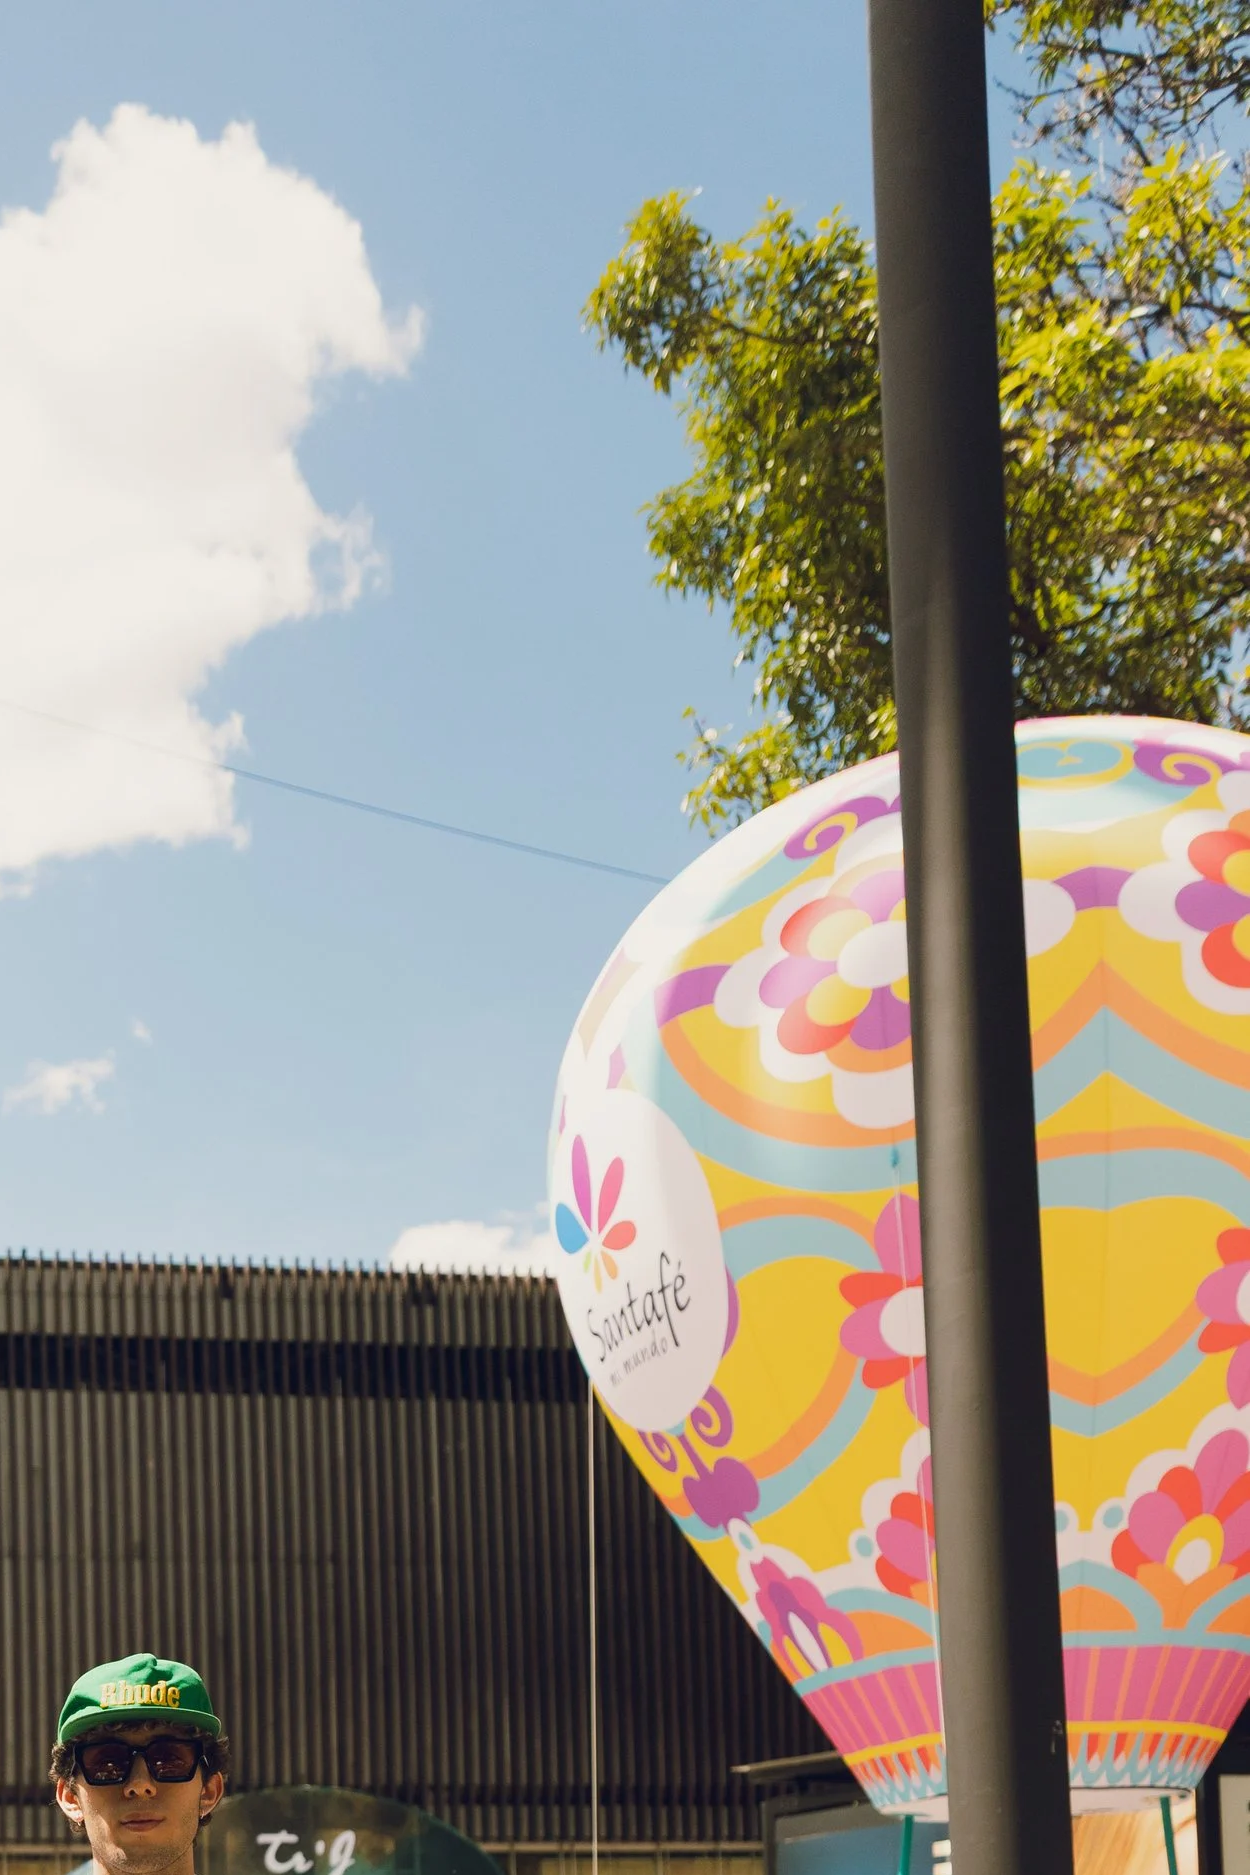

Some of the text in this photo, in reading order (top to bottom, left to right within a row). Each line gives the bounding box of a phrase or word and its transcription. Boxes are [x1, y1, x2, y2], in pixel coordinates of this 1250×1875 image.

[588, 1252, 691, 1363] Santafé
[623, 1329, 668, 1375] mundo
[100, 1680, 180, 1709] Rhude
